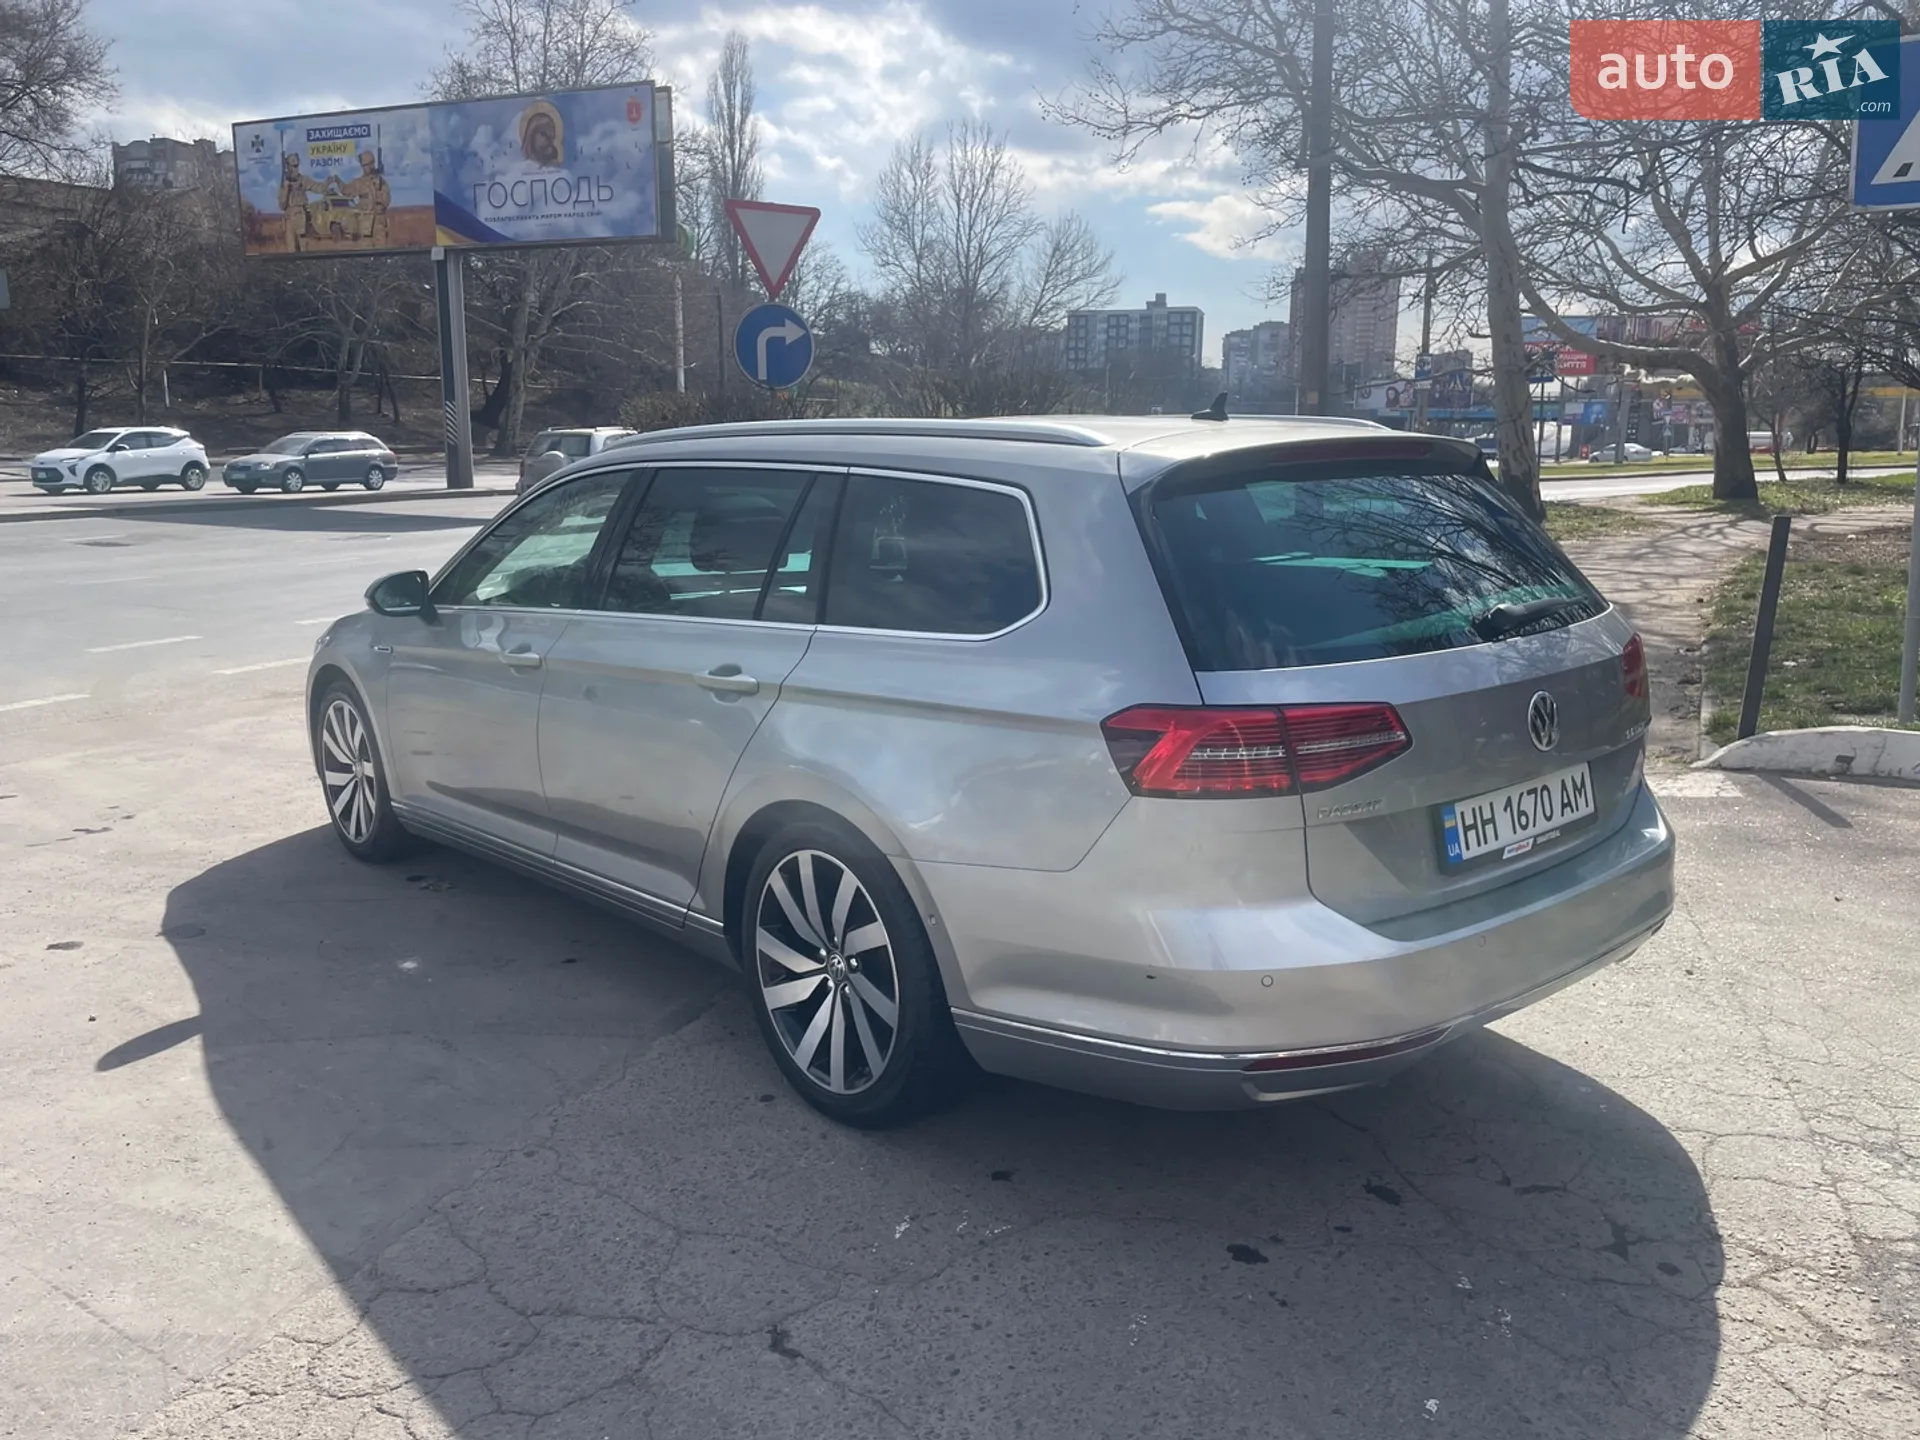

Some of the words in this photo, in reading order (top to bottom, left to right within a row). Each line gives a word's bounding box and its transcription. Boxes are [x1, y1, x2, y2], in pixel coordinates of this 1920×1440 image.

[308, 126, 369, 140] ЗАХИЩАЄМО
[309, 143, 348, 155] УКРАЇНУ
[310, 157, 344, 168] РАЗОМ!
[473, 175, 614, 210] ГОСПОДЬ
[1460, 801, 1499, 851] HH
[1503, 784, 1554, 835] 1670
[1561, 771, 1589, 817] AM
[1448, 843, 1461, 857] UA
